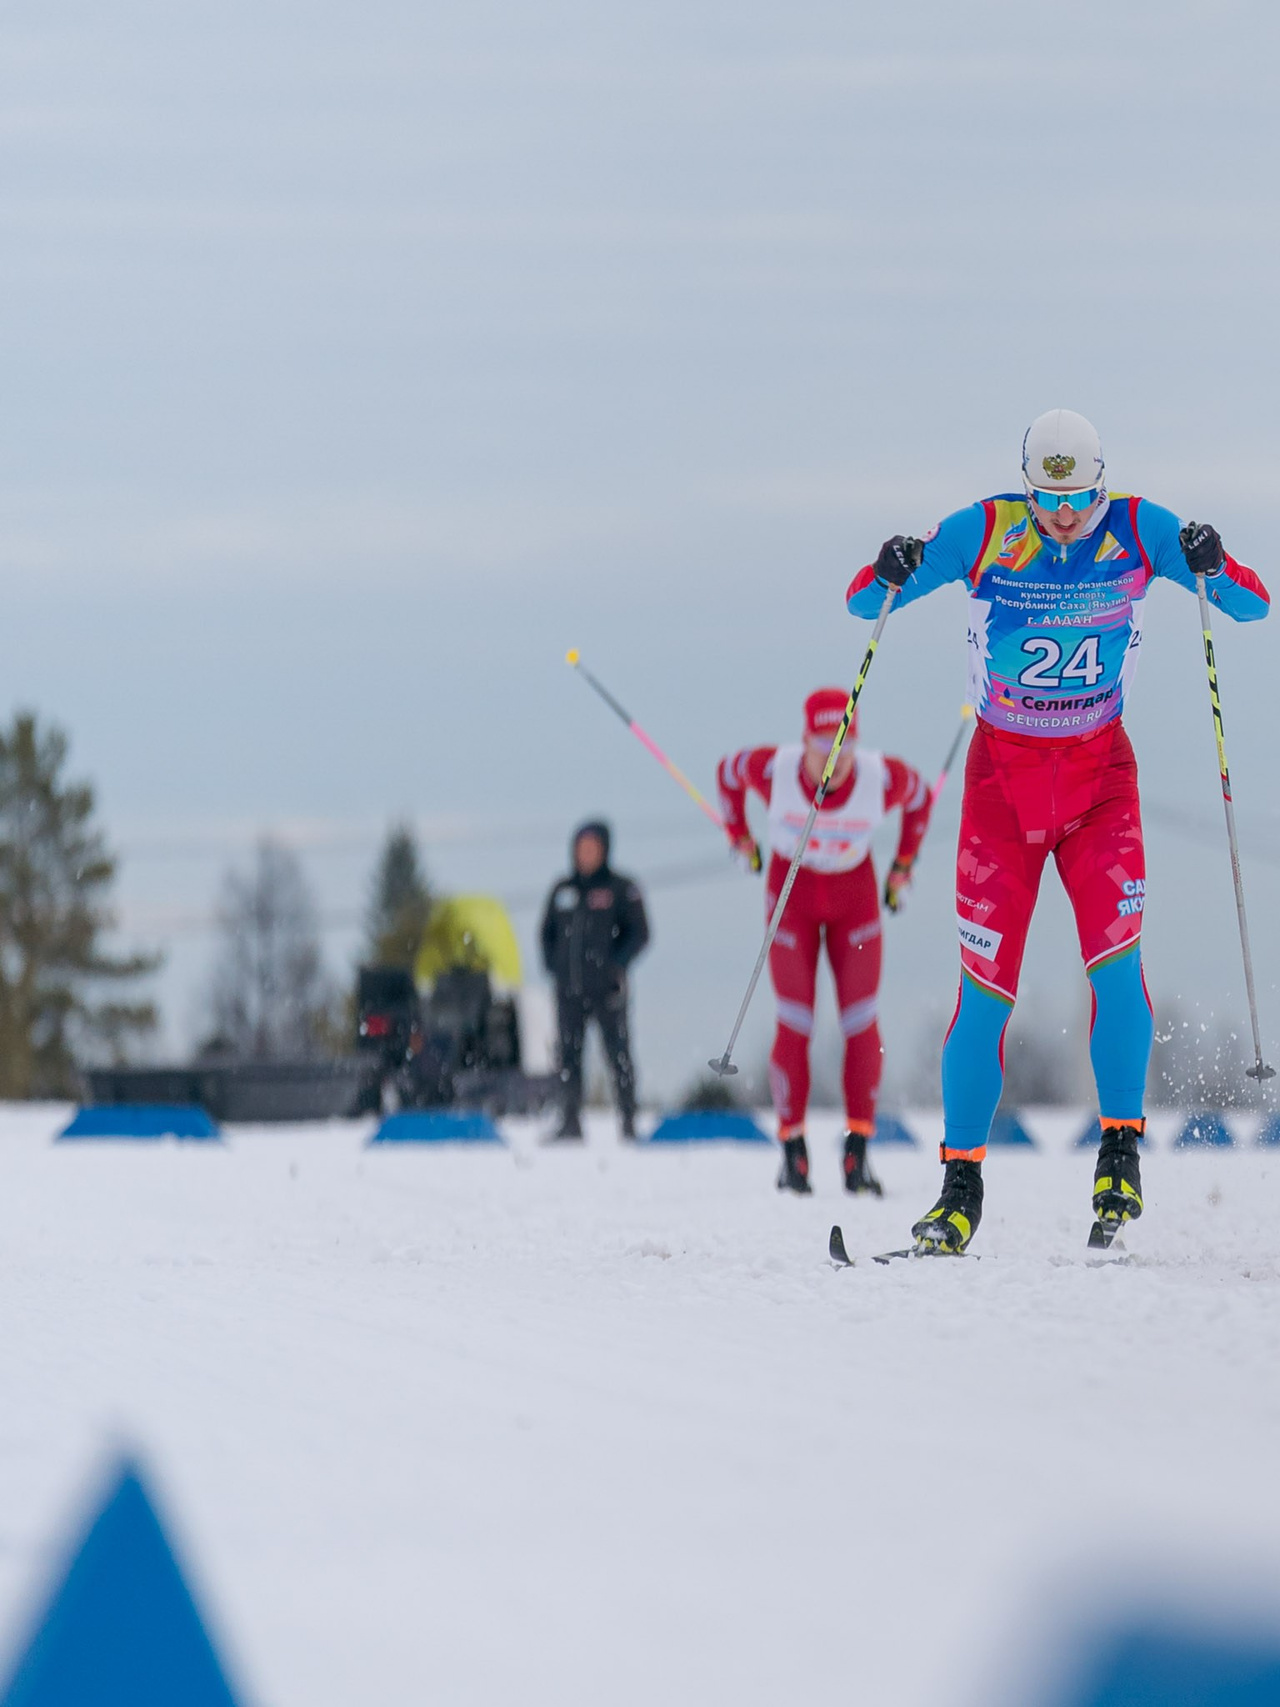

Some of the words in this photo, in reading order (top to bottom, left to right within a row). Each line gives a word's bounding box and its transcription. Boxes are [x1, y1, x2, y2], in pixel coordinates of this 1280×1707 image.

[1188, 530, 1208, 550] LEKI
[992, 575, 1061, 590] Министерство
[995, 595, 1056, 610] Республики
[1059, 601, 1085, 610] Саха
[1021, 591, 1062, 600] культуре
[1073, 591, 1106, 600] спорту
[1027, 616, 1037, 625] г.
[1042, 615, 1093, 626] АЛДАН
[1018, 634, 1104, 689] 24
[1021, 688, 1114, 711] Селигдар
[1006, 709, 1102, 728] SELIGDAR.RU
